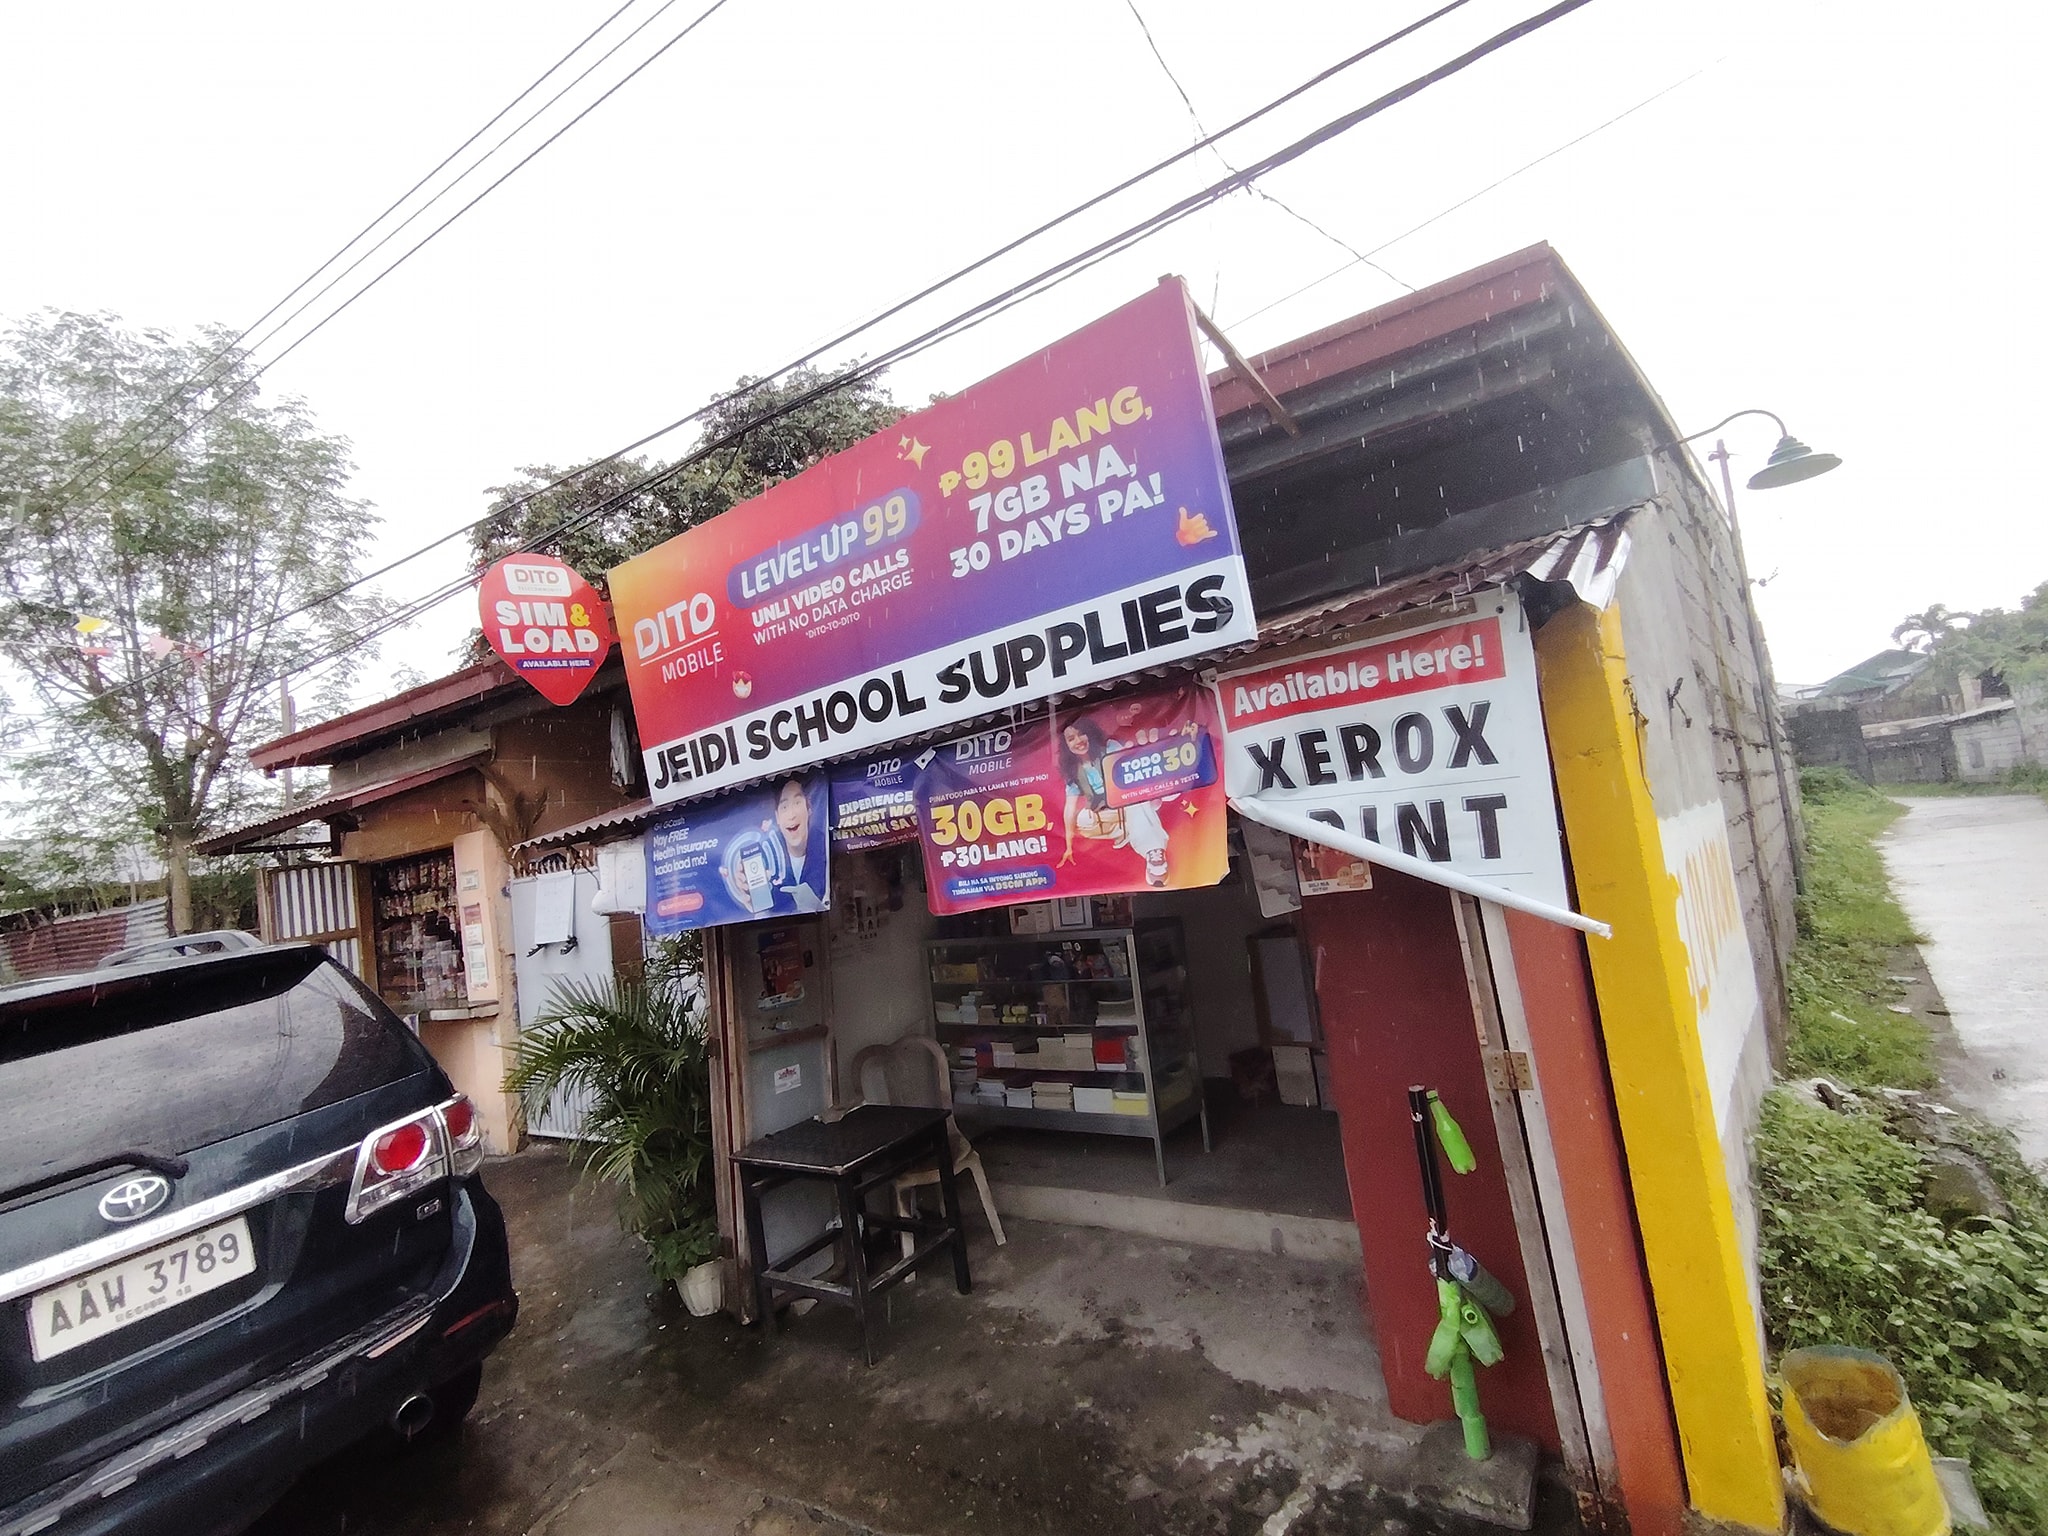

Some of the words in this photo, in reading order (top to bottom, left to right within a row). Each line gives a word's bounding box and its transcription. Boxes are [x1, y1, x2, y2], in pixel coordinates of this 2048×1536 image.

[1020, 386, 1153, 467] LANG,
[969, 474, 1051, 533] 7GB
[1059, 444, 1138, 499] NA,
[949, 541, 991, 578] 30
[997, 502, 1090, 562] DAYS
[1098, 472, 1165, 524] PA!
[740, 521, 859, 599] LEVEL-UP
[863, 496, 907, 546] 99
[514, 569, 560, 584] DITO
[752, 598, 791, 628] UNLI
[791, 576, 845, 610] VIDEO
[848, 548, 910, 587] CALLS
[633, 592, 716, 660] DITO
[752, 619, 787, 646] WITH
[789, 609, 809, 631] NO
[813, 597, 848, 622] DATA
[499, 628, 599, 653] LOAD
[522, 659, 568, 668] AVAILABLE
[569, 659, 591, 667] HERE
[662, 642, 724, 683] MOBILE
[654, 726, 740, 790] JEIDI
[746, 669, 926, 760] SCHOOL
[936, 574, 1234, 704] SUPPLIES
[1233, 660, 1380, 718] Available
[1386, 635, 1486, 683] Here!
[956, 730, 1012, 761] DITO
[1162, 742, 1197, 772] 30
[1244, 699, 1499, 791] XEROX
[866, 758, 900, 777] DITO
[969, 757, 1012, 776] MOBILE
[1121, 753, 1161, 772] TODO
[1123, 765, 1163, 784] DATA
[874, 775, 903, 787] MOBILE
[1154, 780, 1174, 791] CALLS
[1180, 773, 1200, 784] TEXTS
[838, 790, 914, 816] EXPERIENCE
[838, 808, 887, 828] FASTEST
[889, 804, 916, 818] MO
[832, 823, 890, 840] NETWORK
[890, 818, 911, 831] SA
[930, 794, 1054, 846] 30GB,
[668, 828, 690, 842] FREE
[676, 838, 719, 854] Insurance
[982, 836, 1048, 861] LANG!
[995, 880, 1024, 891] DSCM
[50, 1274, 127, 1338] AAW
[144, 1233, 240, 1295] 3789
